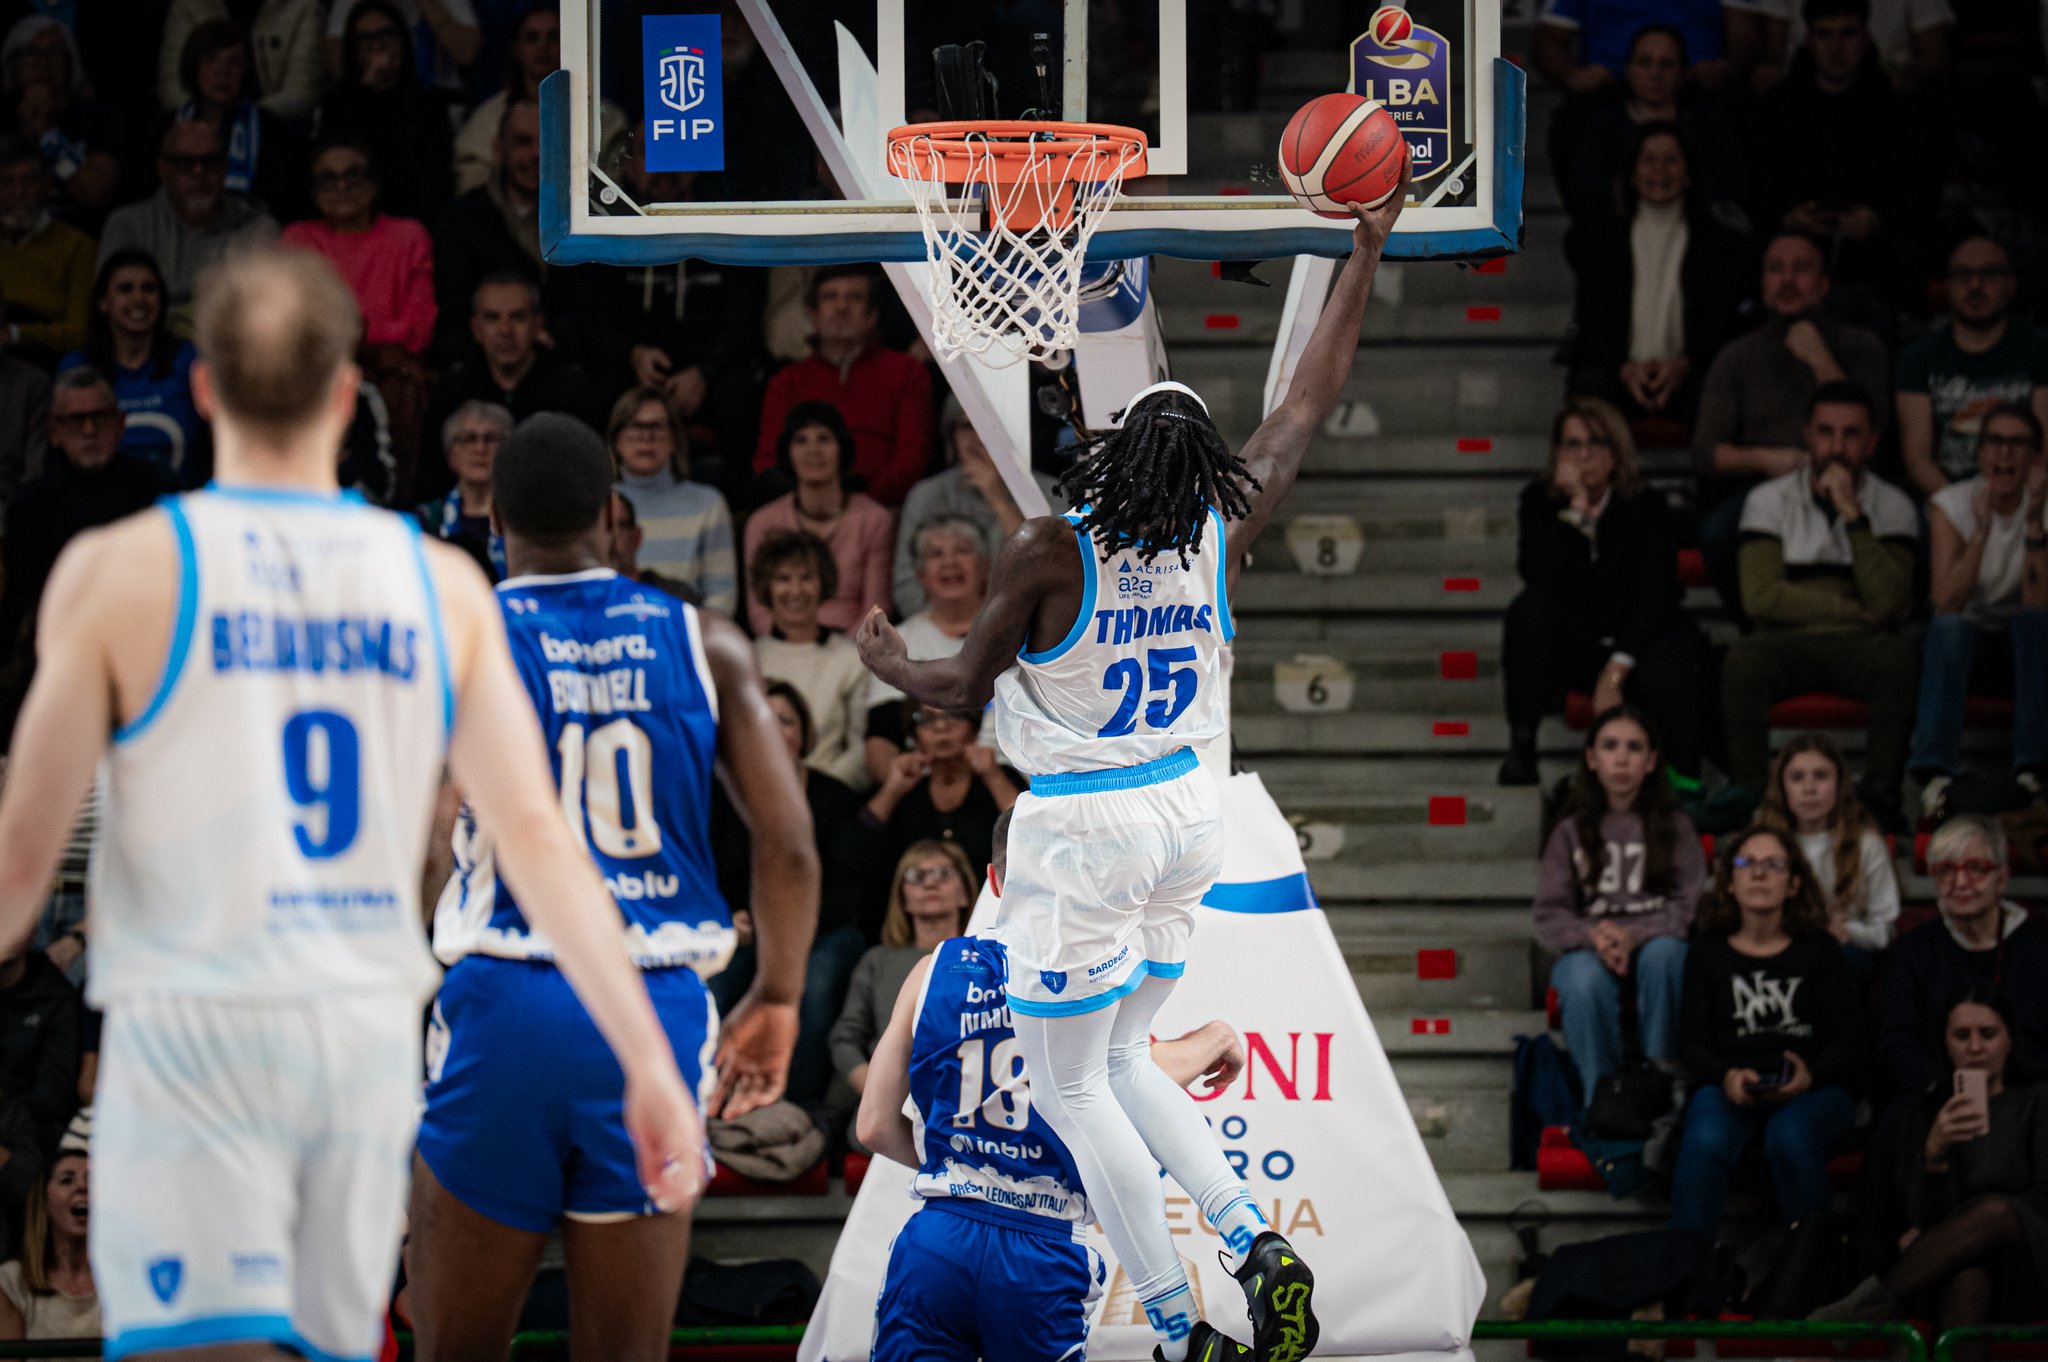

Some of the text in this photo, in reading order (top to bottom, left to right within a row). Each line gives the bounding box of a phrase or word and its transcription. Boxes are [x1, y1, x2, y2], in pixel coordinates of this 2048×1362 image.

[1366, 79, 1439, 105] LBA
[653, 118, 715, 140] FIP
[1317, 536, 1337, 568] 8
[1119, 576, 1152, 593] a2a
[1095, 604, 1212, 645] THOMAS
[1097, 646, 1197, 738] 25
[1307, 674, 1328, 705] 6
[283, 710, 358, 858] 9
[558, 718, 662, 859] 10
[953, 1038, 1031, 1131] 18
